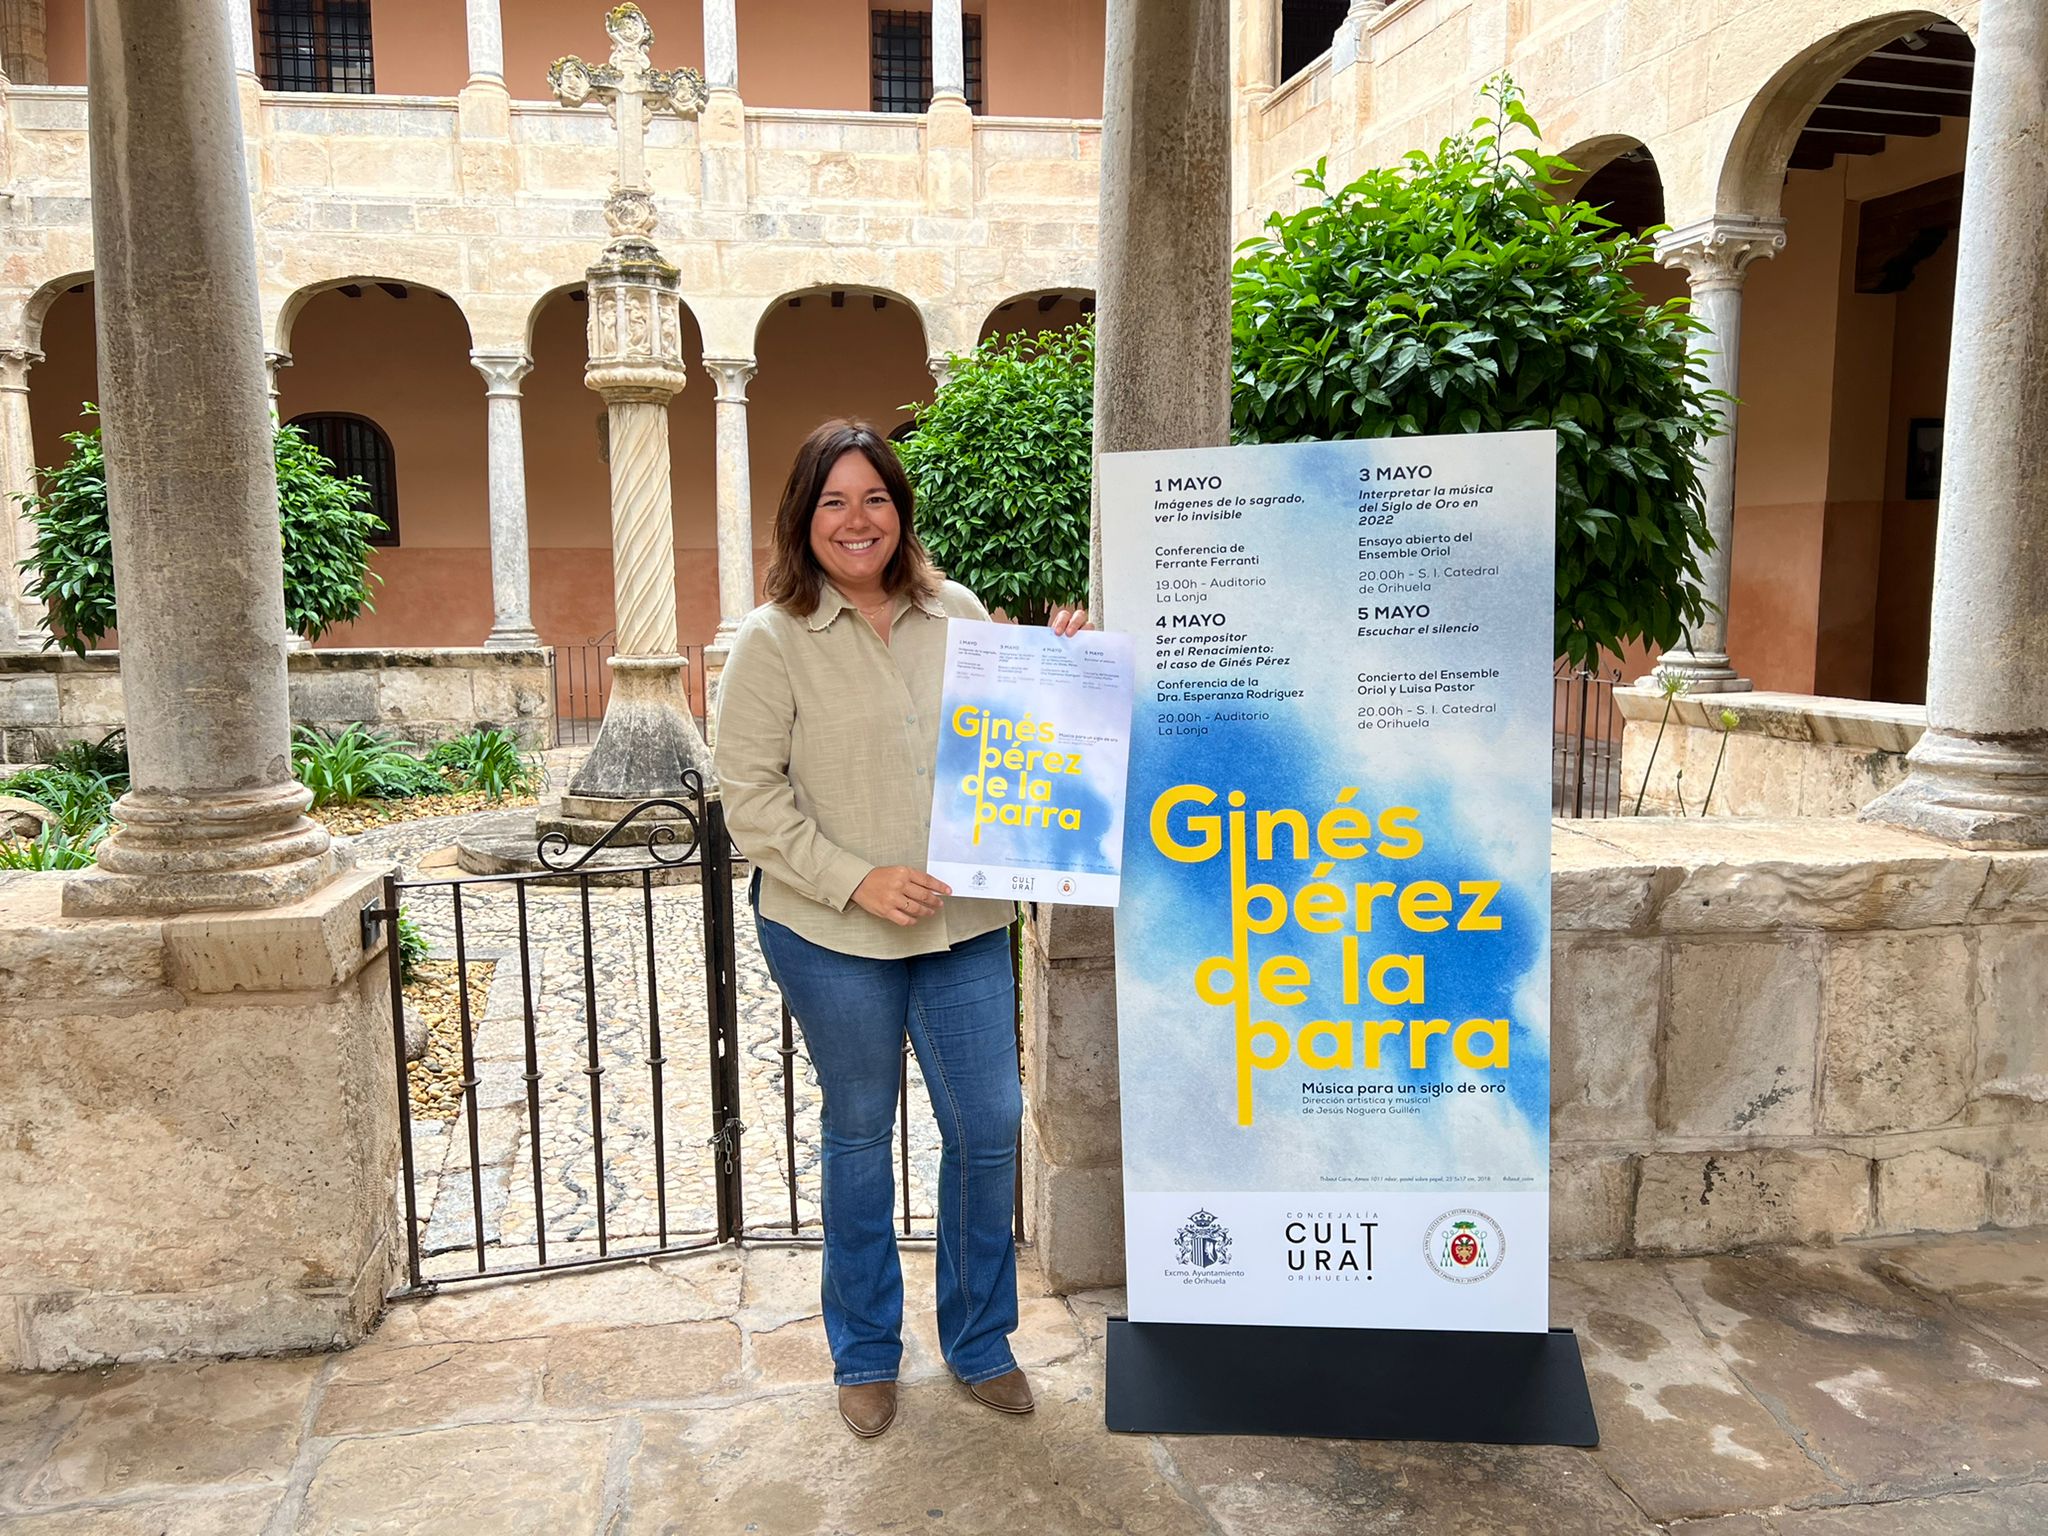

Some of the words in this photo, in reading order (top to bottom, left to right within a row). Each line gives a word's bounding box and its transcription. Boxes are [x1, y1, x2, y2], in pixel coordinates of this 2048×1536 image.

[1359, 468, 1370, 481] 3
[1377, 466, 1432, 480] MAYO
[1154, 479, 1162, 492] 1
[1168, 476, 1222, 492] MAYO
[1359, 486, 1430, 500] Interpretar
[1434, 486, 1446, 496] la
[1448, 485, 1493, 496] música
[1154, 498, 1213, 512] Imágenes
[1216, 497, 1232, 507] de
[1235, 496, 1246, 506] lo
[1249, 494, 1305, 508] sagrado,
[1358, 503, 1378, 512] del
[1381, 501, 1412, 514] Siglo
[1416, 500, 1432, 510] de
[1435, 498, 1459, 510] Oro
[1462, 499, 1478, 508] en
[1154, 513, 1174, 522] ver
[1177, 512, 1188, 522] lo
[1192, 510, 1242, 521] invisible
[1358, 516, 1394, 526] 2022
[1358, 536, 1402, 549] Ensayo
[1406, 534, 1451, 545] abierto
[1454, 532, 1472, 543] del
[1155, 544, 1227, 556] Conferencia
[1230, 544, 1244, 554] de
[1358, 548, 1418, 560] Ensemble
[1421, 546, 1450, 558] Oriol
[1155, 557, 1207, 568] Ferrante
[1211, 555, 1259, 566] Ferranti
[1359, 570, 1404, 581] 20.00h
[1418, 568, 1430, 578] S.
[1444, 566, 1499, 578] Catedral
[1156, 578, 1197, 590] 19.00h
[1210, 576, 1266, 588] Auditorio
[1359, 584, 1374, 594] de
[1378, 582, 1431, 594] Orihuela
[1156, 592, 1171, 602] La
[1175, 592, 1208, 604] Lonja
[1358, 607, 1368, 620] 5
[1374, 604, 1430, 619] MAYO
[1156, 616, 1167, 628] 4
[1172, 613, 1226, 628] MAYO
[1358, 625, 1416, 636] Escuchar
[1418, 624, 1429, 634] el
[1432, 622, 1479, 634] silencio
[1156, 634, 1176, 645] Ser
[1179, 632, 1247, 646] compositor
[1156, 648, 1171, 657] en
[1174, 647, 1184, 656] el
[1188, 644, 1274, 656] Renacimiento:
[1156, 660, 1168, 670] el
[1170, 660, 1198, 669] caso
[1200, 658, 1216, 668] de
[1218, 656, 1252, 668] Ginés
[1256, 656, 1290, 666] Pérez
[1358, 670, 1416, 682] Concierto
[1419, 670, 1438, 680] del
[1441, 668, 1500, 680] Ensemble
[1157, 678, 1228, 690] Conferencia
[1231, 678, 1245, 688] de
[1248, 677, 1258, 686] la
[1358, 684, 1386, 696] Oriol
[1390, 686, 1396, 696] y
[1400, 683, 1432, 694] Luisa
[1434, 682, 1475, 692] Pastor
[1157, 691, 1181, 702] Dra.
[1184, 690, 1244, 704] Esperanza
[1158, 712, 1202, 724] 20.00h
[1214, 710, 1270, 722] Auditorio
[1358, 706, 1403, 717] 20.00h
[1416, 705, 1428, 715] S.
[1442, 703, 1496, 714] Catedral
[952, 705, 1055, 743] Ginés
[1158, 726, 1173, 736] La
[1176, 725, 1208, 736] Lonja
[1358, 720, 1373, 730] de
[1376, 718, 1430, 729] Orihuela
[977, 740, 1083, 775] pérez
[961, 774, 1008, 798] de
[1019, 771, 1052, 801] la
[973, 802, 1081, 845] parra
[1150, 784, 1424, 862] Ginés
[1234, 862, 1502, 935] pérez
[1194, 954, 1311, 1006] de
[1342, 935, 1425, 1004] la
[1235, 1017, 1510, 1126] parra
[1302, 1083, 1353, 1094] Música
[1358, 1085, 1393, 1096] para
[1398, 1085, 1415, 1093] un
[1420, 1082, 1453, 1097] siglo
[1458, 1082, 1476, 1093] de
[1480, 1084, 1505, 1093] oro
[1346, 1107, 1386, 1116] Noguera
